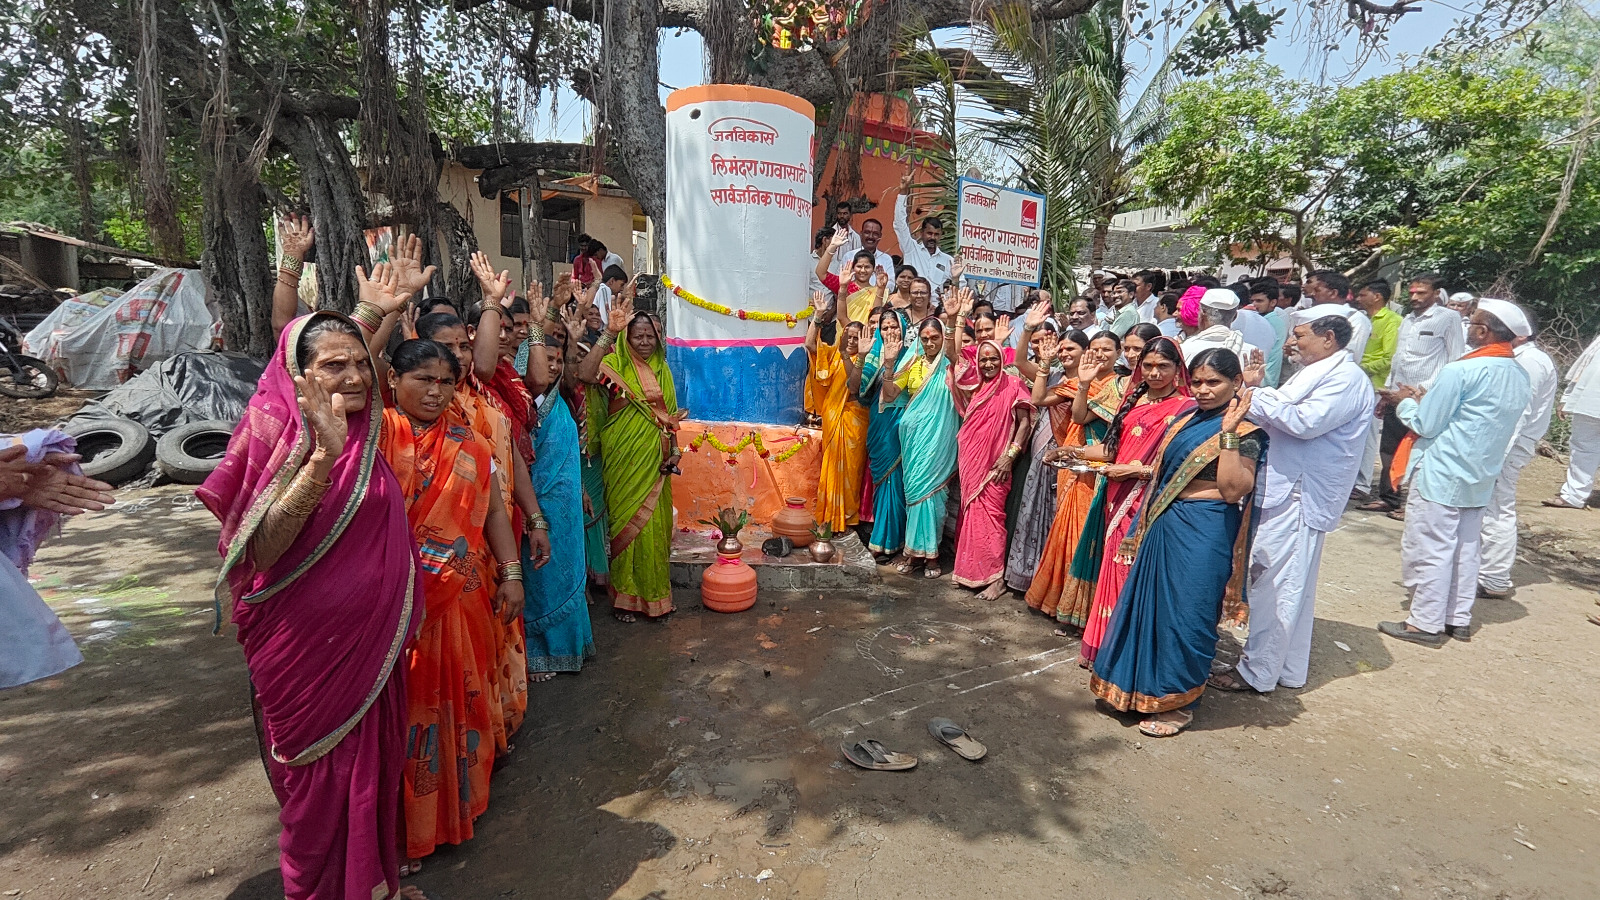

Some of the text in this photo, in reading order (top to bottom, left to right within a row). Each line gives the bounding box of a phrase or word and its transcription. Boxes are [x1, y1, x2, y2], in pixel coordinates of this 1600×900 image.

[711, 126, 774, 145] जनविकास
[710, 153, 758, 179] लिमंदरा
[710, 184, 773, 206] सार्वजनिक
[774, 189, 797, 210] पाणी
[964, 192, 997, 210] जनविकास
[962, 219, 996, 244] लिमंदरा
[997, 230, 1039, 250] गावासाठी
[996, 249, 1015, 266] पाणी
[1016, 255, 1039, 271] पुरवठा
